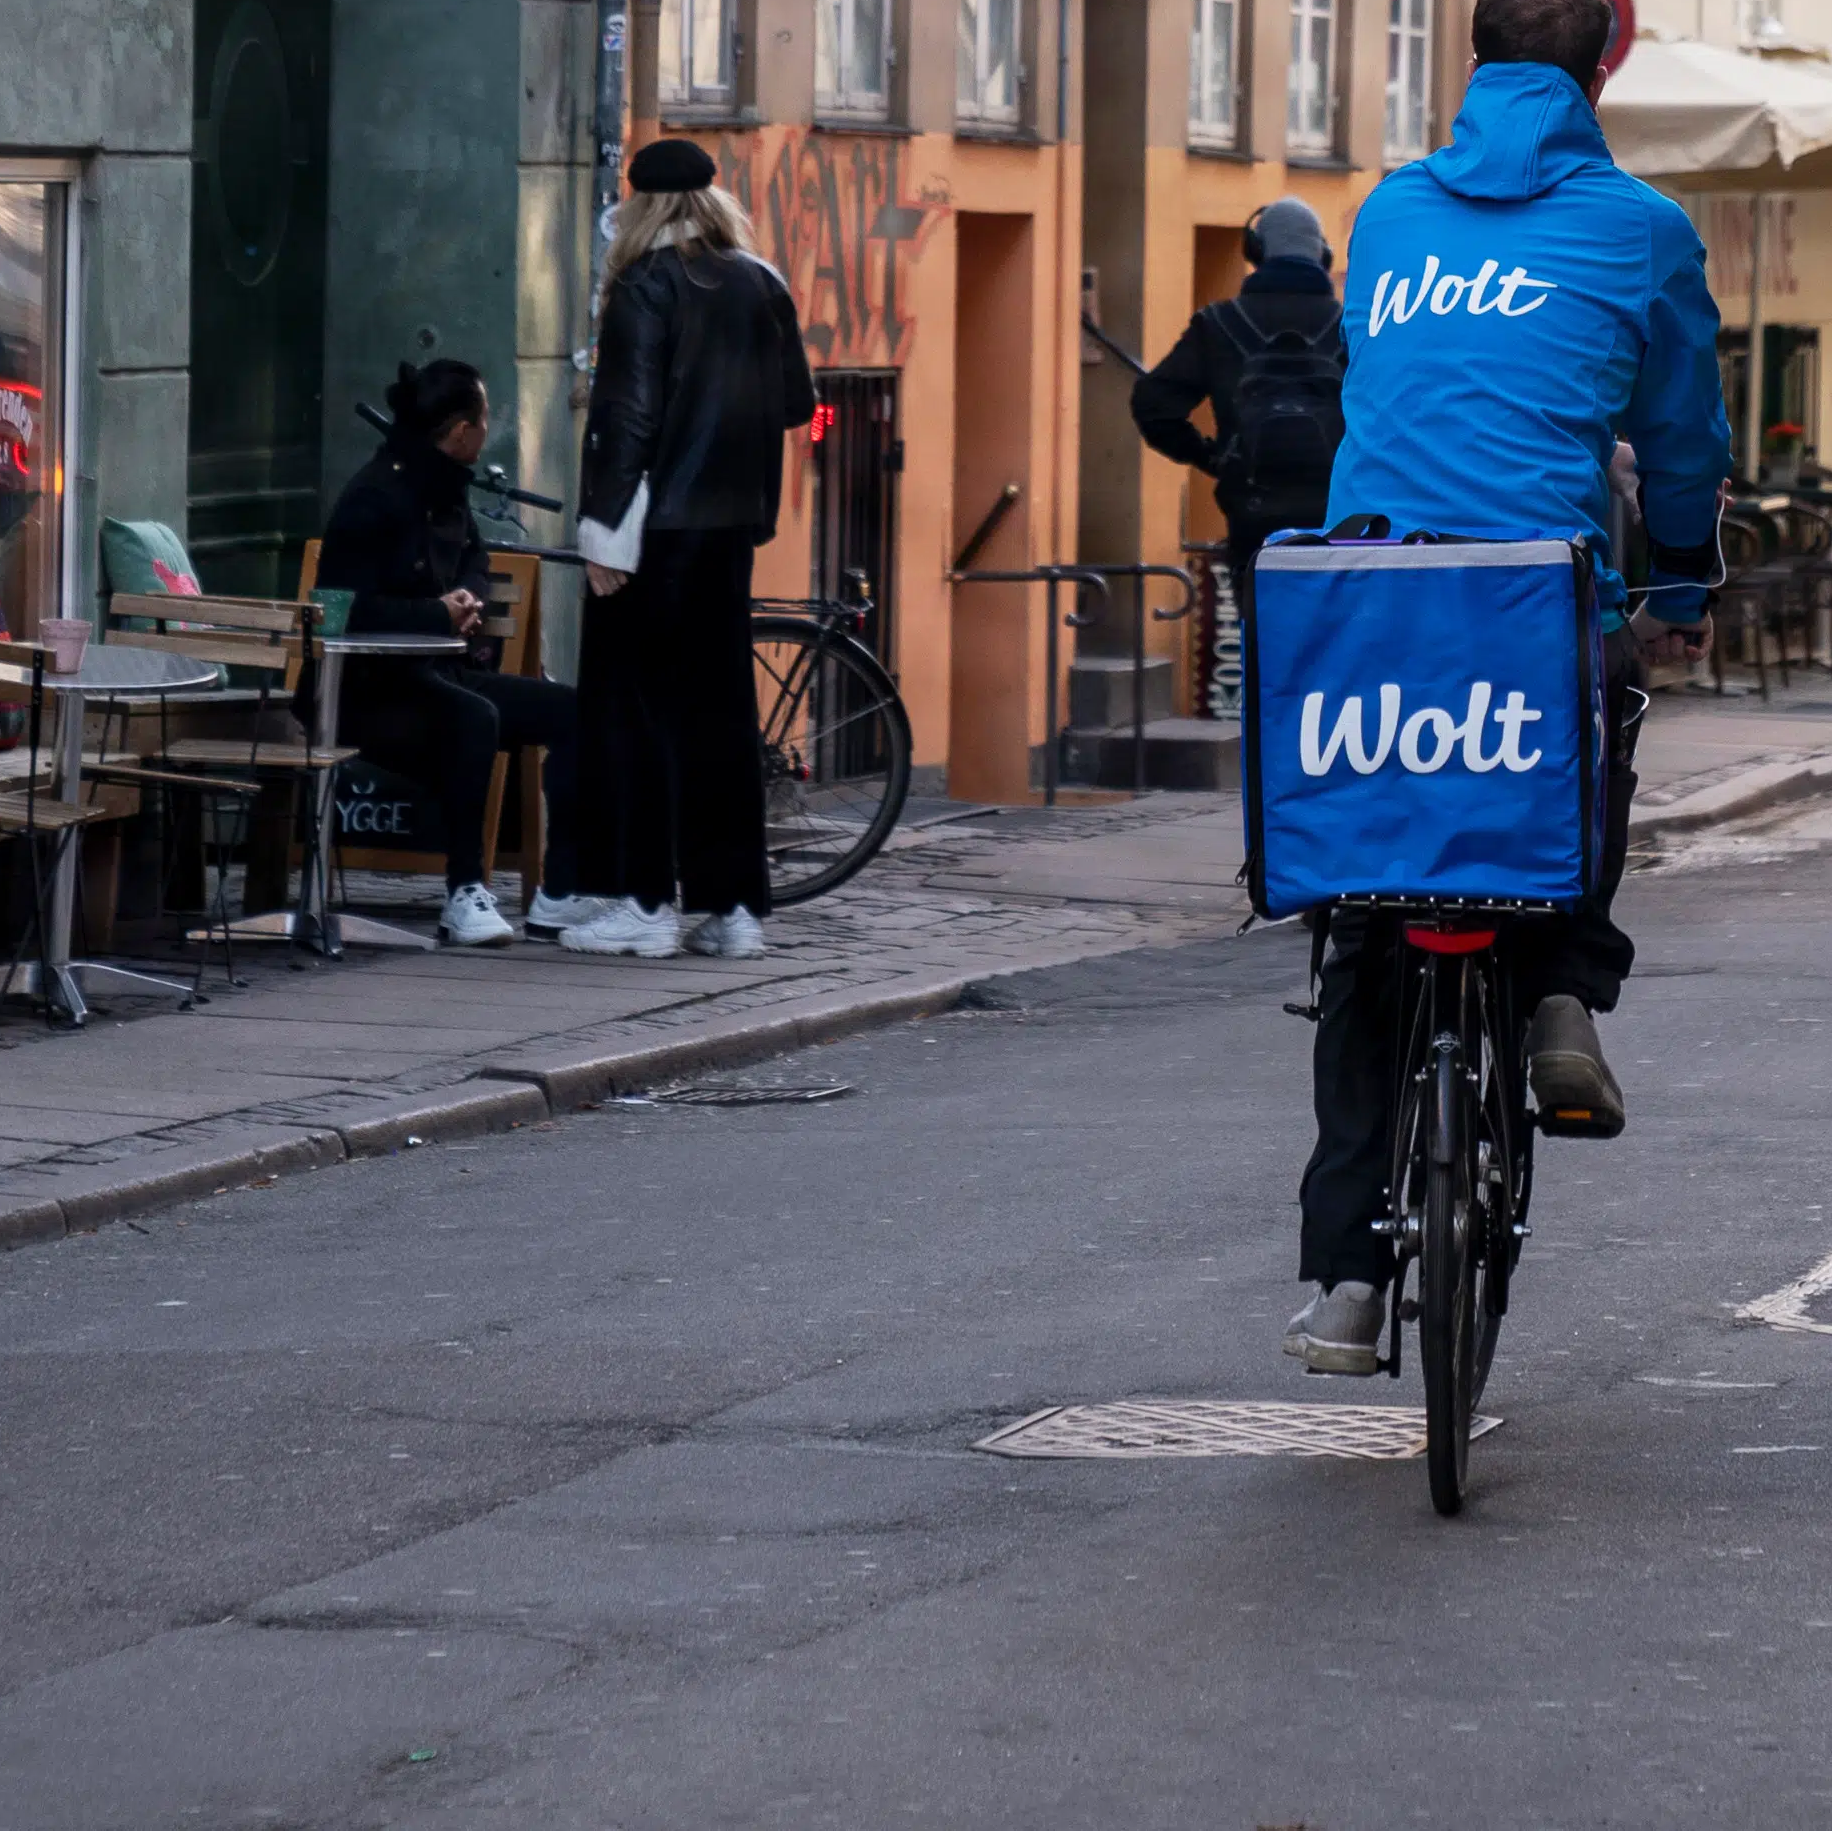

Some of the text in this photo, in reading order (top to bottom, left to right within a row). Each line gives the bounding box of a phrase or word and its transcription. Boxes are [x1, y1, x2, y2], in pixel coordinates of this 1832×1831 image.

[1369, 255, 1557, 338] Wolt
[1299, 681, 1542, 777] Wolt
[335, 800, 413, 835] YGGE
